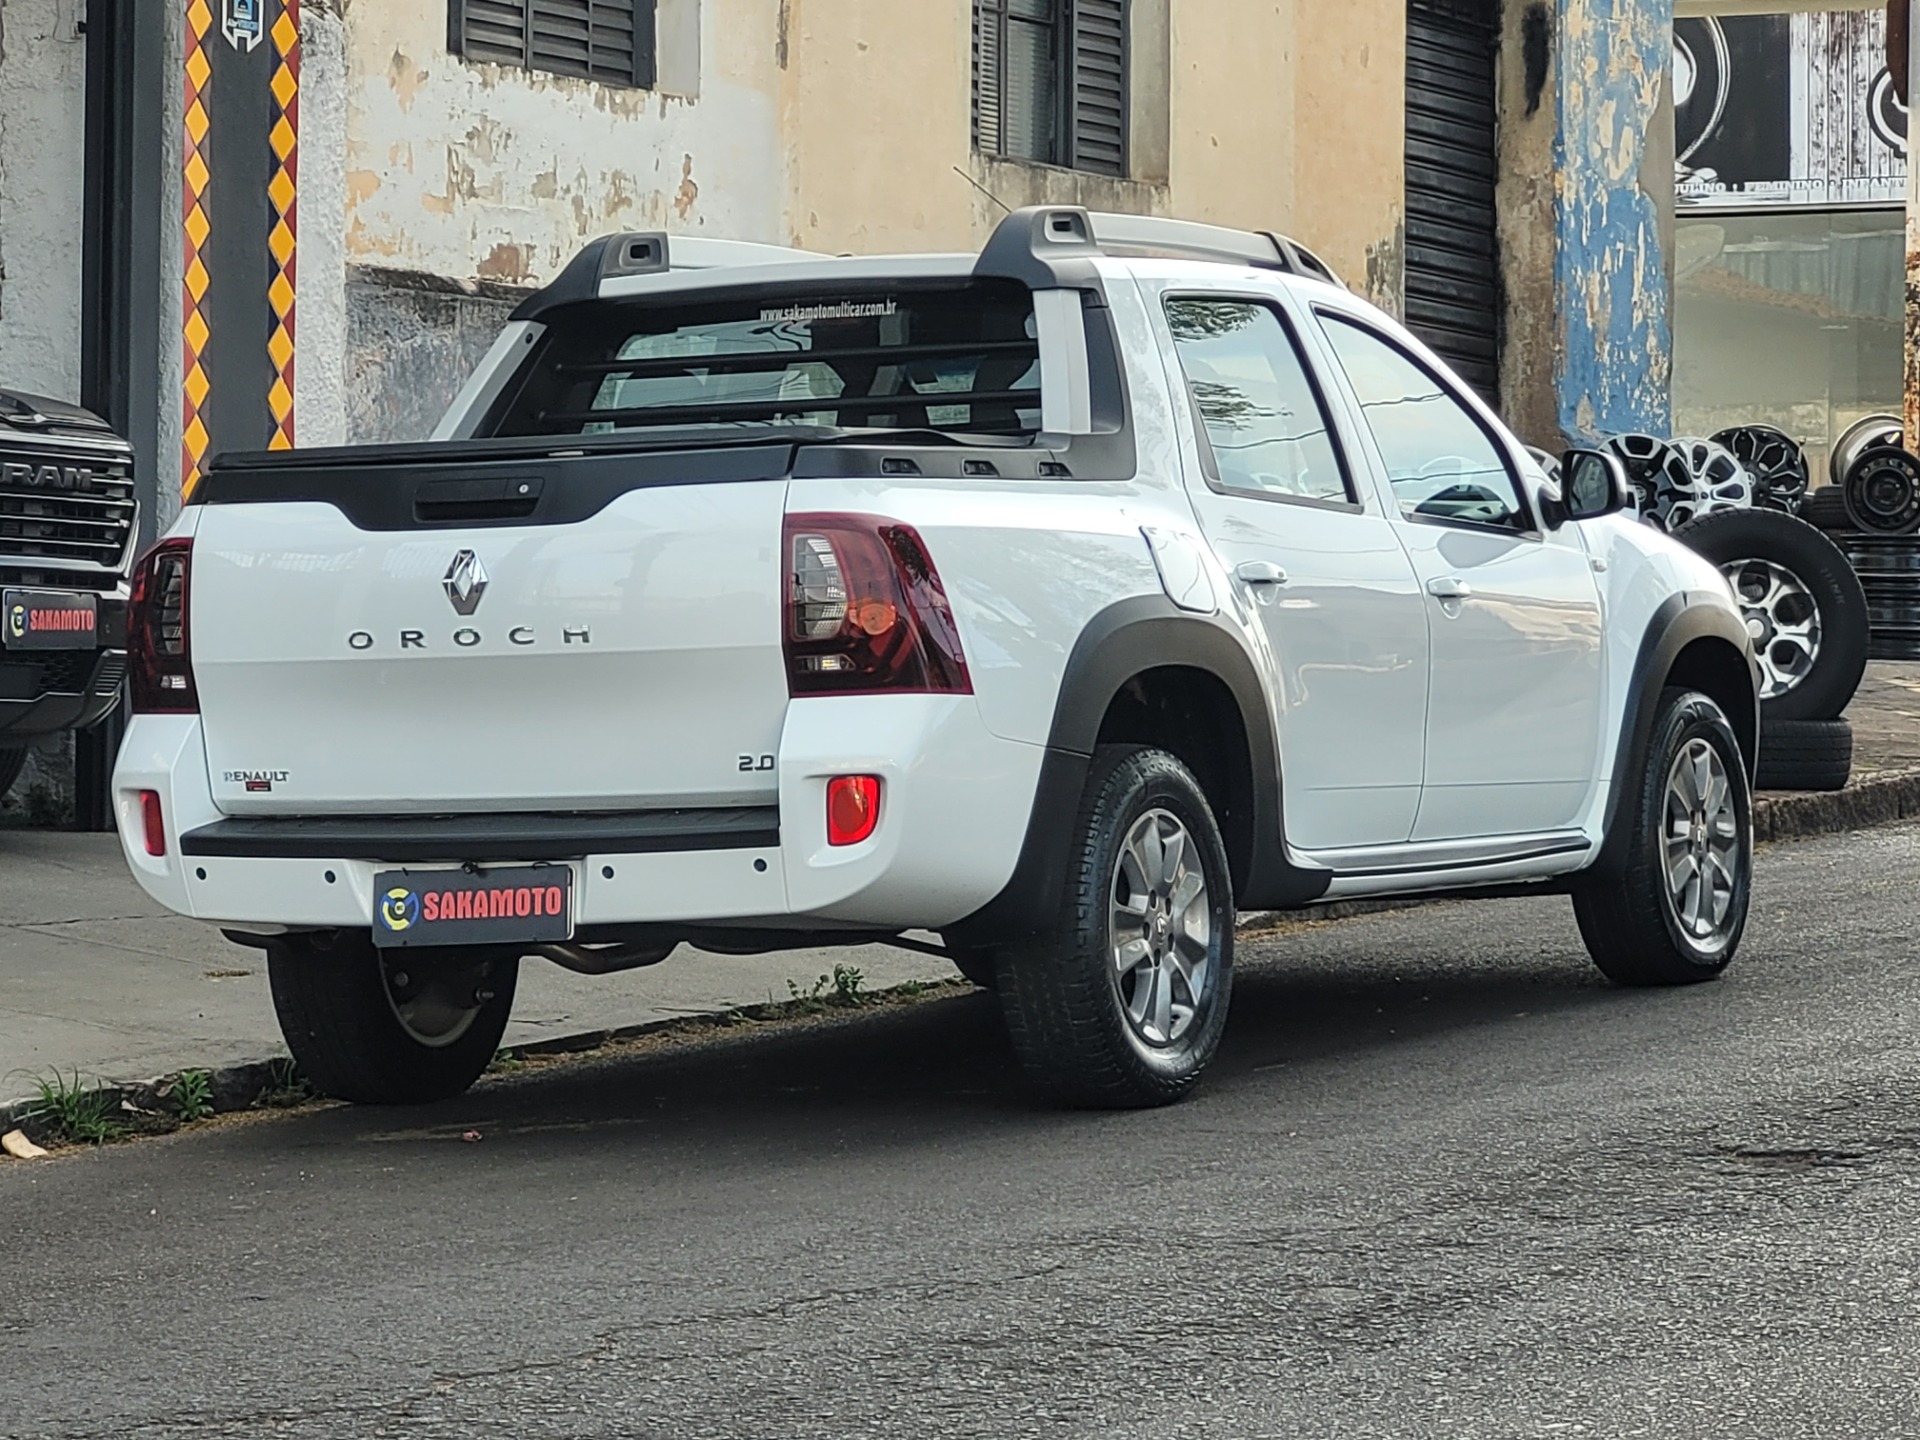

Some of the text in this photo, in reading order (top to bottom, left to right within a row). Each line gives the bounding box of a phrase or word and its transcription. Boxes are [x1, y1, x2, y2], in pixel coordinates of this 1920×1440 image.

[1744, 179, 1824, 192] FEMININO
[760, 299, 897, 322] www.sakamotomulticar.com.br
[2, 461, 92, 488] RAM
[29, 609, 95, 631] SAKAMOTO
[348, 624, 590, 650] OROCH
[223, 770, 290, 782] RENAULT
[423, 886, 562, 921] SAKAMOTO
